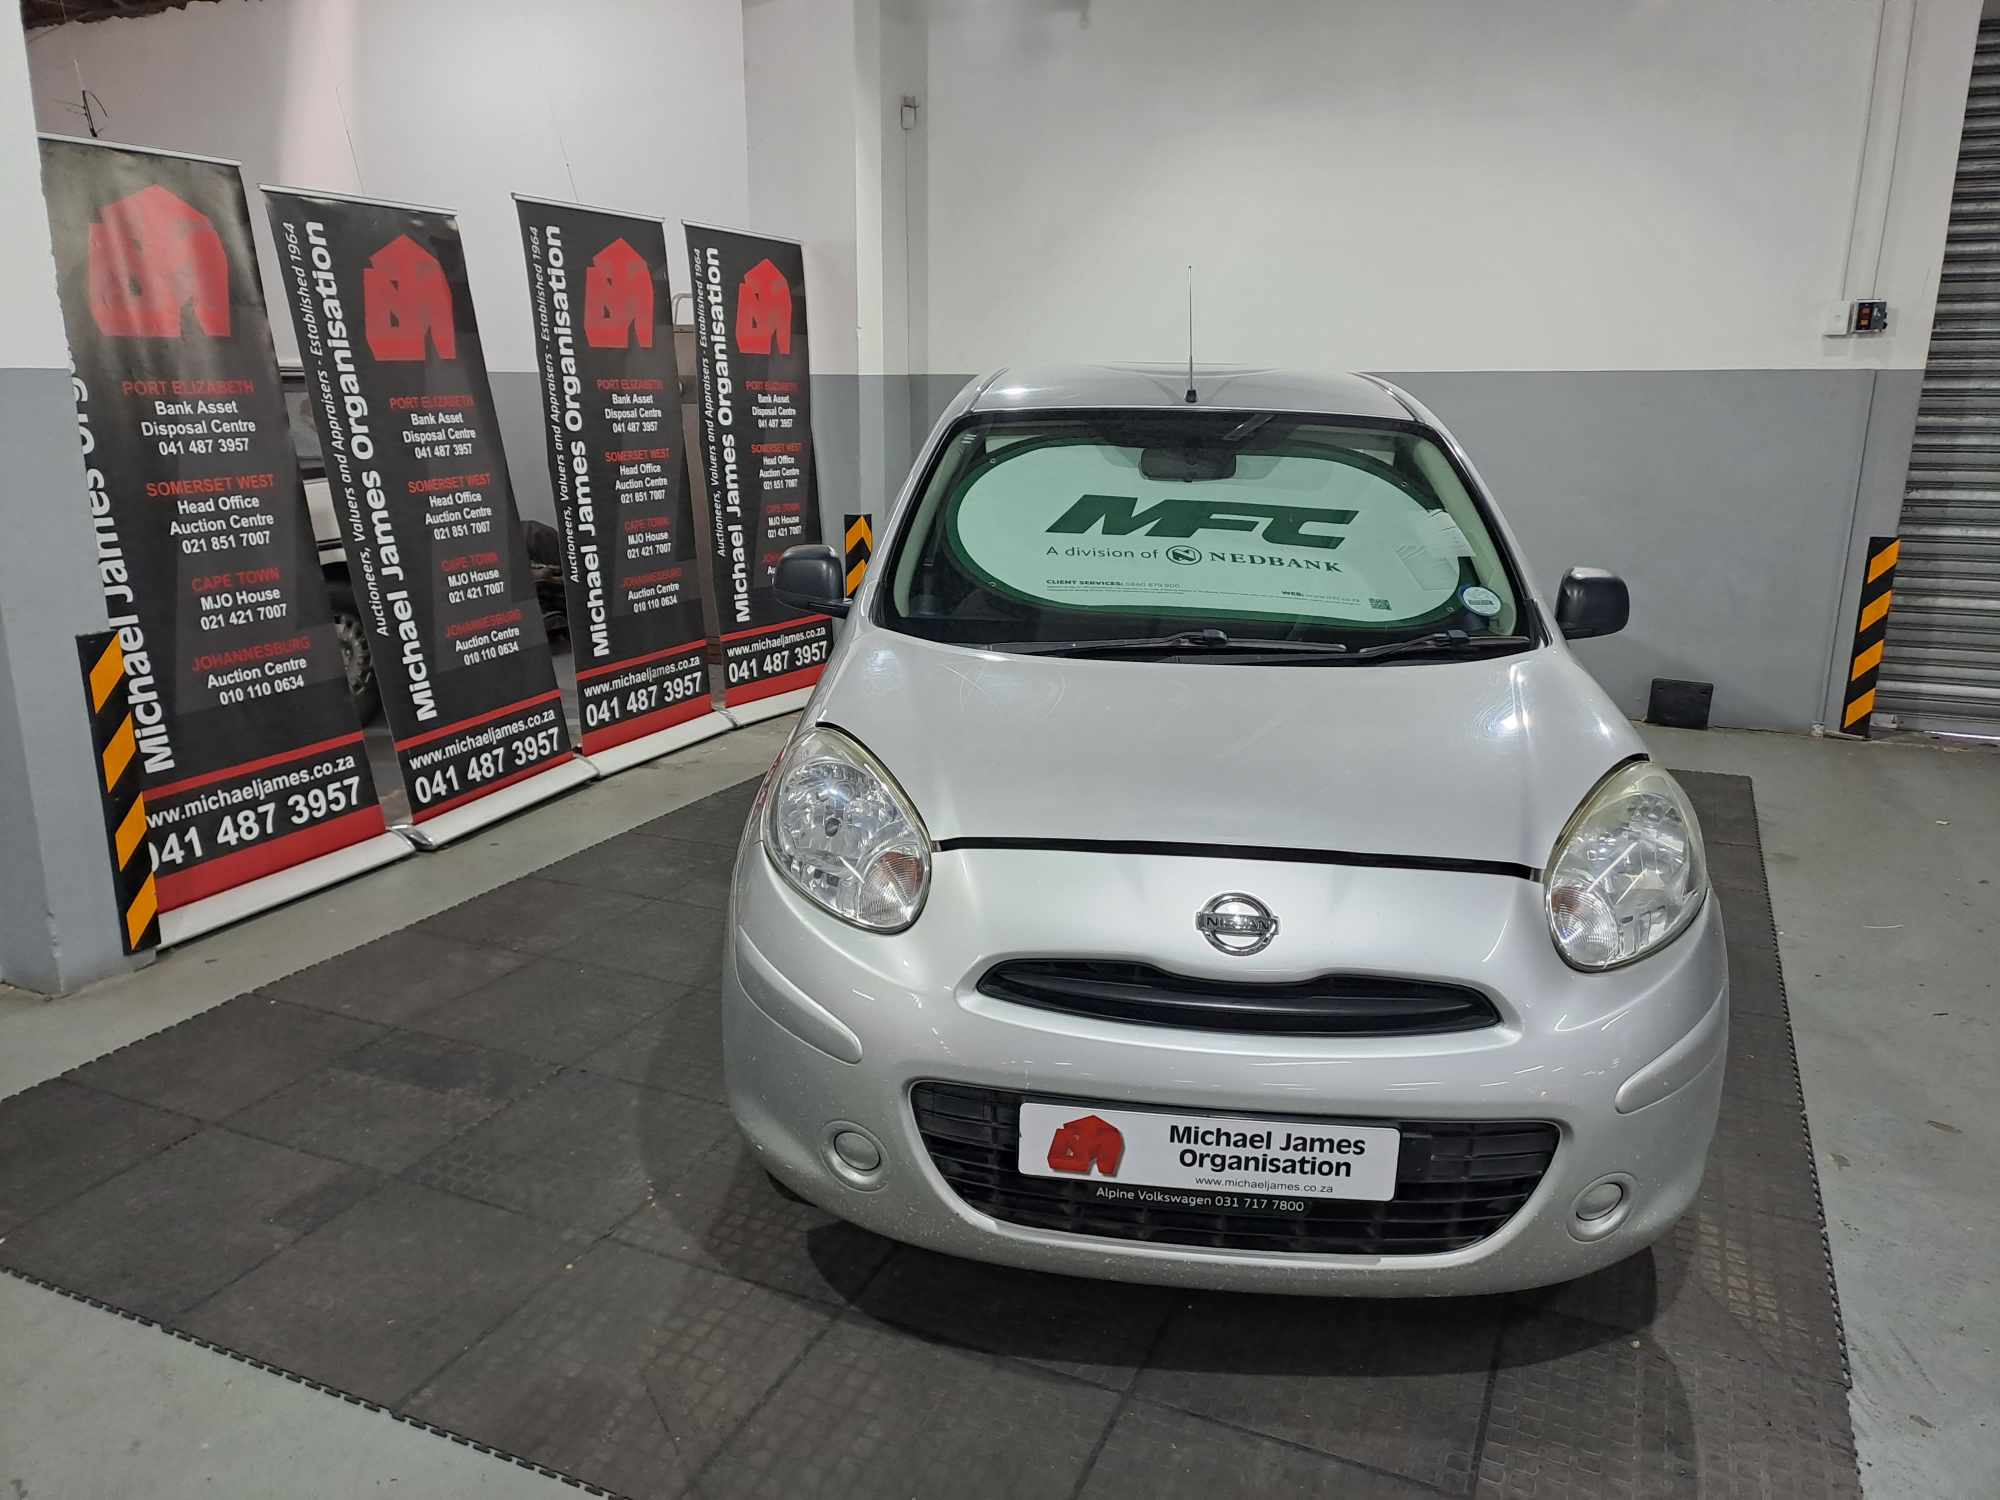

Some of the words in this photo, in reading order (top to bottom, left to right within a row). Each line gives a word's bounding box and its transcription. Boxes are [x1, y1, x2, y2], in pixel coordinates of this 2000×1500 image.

[283, 222, 302, 262] 1964
[529, 226, 543, 260] 1964
[292, 265, 324, 357] Established
[533, 263, 550, 341] Established
[306, 221, 374, 460] Organisation
[545, 225, 583, 432] Organisation
[706, 247, 733, 426] Organisation
[122, 380, 167, 396] PORT
[545, 352, 561, 423] Appraisers
[612, 393, 632, 405] Bank
[632, 393, 653, 404] Asset
[700, 357, 714, 418] Appraisers
[154, 401, 194, 416] Bank
[197, 400, 238, 415] Asset
[317, 370, 345, 450] Appraisers
[410, 413, 437, 425] Bank
[438, 412, 463, 424] Asset
[604, 408, 637, 420] Disposal
[639, 407, 662, 418] Centre
[141, 421, 207, 438] Disposal
[211, 419, 256, 433] Centre
[402, 429, 446, 444] Disposal
[448, 428, 476, 440] Centre
[551, 424, 563, 451] and
[612, 422, 626, 433] 041
[705, 420, 716, 443] and
[158, 441, 184, 456] 041
[189, 439, 213, 454] 487
[218, 437, 249, 452] 3957
[414, 447, 432, 459] 041
[434, 444, 450, 457] 487
[453, 443, 472, 456] 3957
[334, 454, 352, 483] and
[556, 454, 570, 501] Valuers
[620, 465, 638, 476] Head
[640, 463, 662, 474] Office
[709, 445, 719, 486] Valuers
[722, 434, 741, 518] James
[147, 477, 232, 497] SOMERSET
[237, 474, 274, 489] WEST
[570, 441, 597, 536] James
[615, 480, 643, 490] Auction
[645, 477, 668, 487] Centre
[177, 498, 214, 515] Head
[218, 495, 260, 510] Office
[429, 494, 453, 508] Head
[455, 491, 482, 504] Office
[620, 493, 633, 504] 021
[170, 518, 226, 535] Auction
[230, 513, 274, 529] Centre
[345, 487, 366, 542] Valuers
[362, 471, 404, 581] James
[425, 510, 461, 525] Auction
[463, 506, 492, 519] Centre
[1045, 494, 1360, 550] MFC
[86, 468, 133, 602] James
[182, 538, 207, 554] 021
[211, 534, 236, 550] 851
[240, 530, 271, 546] 7007
[433, 527, 450, 540] 021
[452, 524, 468, 538] 851
[470, 521, 491, 535] 7007
[563, 505, 580, 583] Auctioneers,
[628, 533, 644, 545] MJO
[645, 531, 669, 543] House
[627, 548, 639, 559] 021
[641, 546, 653, 557] 421
[655, 543, 671, 555] 7007
[1046, 546, 1058, 557] A
[1065, 546, 1134, 559] division
[1140, 548, 1159, 560] of
[1210, 551, 1342, 573] NEDBANK
[191, 574, 232, 592] CAPE
[237, 567, 281, 584] TOWN
[448, 573, 468, 588] MJO
[470, 569, 499, 583] House
[728, 524, 751, 622] Michael
[200, 593, 232, 611] MJO
[235, 588, 280, 604] House
[360, 547, 390, 637] Auctioneers,
[448, 590, 465, 604] 021
[466, 586, 482, 599] 421
[484, 581, 504, 595] 7007
[580, 545, 610, 657] Michael
[628, 587, 655, 601] Auction
[656, 582, 680, 594] Centre
[200, 614, 225, 631] 021
[229, 609, 253, 625] 421
[257, 603, 287, 620] 7007
[455, 635, 490, 653] Auction
[491, 627, 520, 642] Centre
[727, 627, 826, 658] www.michaeljames.co.za
[387, 590, 438, 722] Michael
[463, 651, 480, 666] 010
[481, 646, 497, 661] 110
[728, 658, 758, 683] 041
[763, 650, 789, 674] 487
[794, 640, 827, 666] 3957
[207, 666, 261, 689] Auction
[264, 657, 307, 676] Centre
[584, 656, 700, 698] www.michaeljames.co.za
[107, 614, 175, 774] Michael
[219, 687, 244, 705] 010
[247, 682, 271, 699] 110
[274, 674, 304, 692] 0634
[586, 696, 620, 727] 041
[626, 685, 658, 713] 487
[664, 671, 702, 702] 3957
[409, 709, 556, 770] www.michaeljames.co.za
[415, 764, 459, 804] 041
[467, 747, 504, 782] 487
[512, 727, 559, 765] 3957
[146, 755, 356, 829] ww.michaeljames.co.za
[217, 802, 276, 846] 487
[287, 776, 360, 824] 3957
[1169, 1125, 1272, 1151] Michael
[1279, 1131, 1367, 1157] James
[1178, 1150, 1352, 1178] Organisation
[1096, 1186, 1135, 1202] Alpine
[1138, 1190, 1212, 1207] Volkswagen
[1214, 1196, 1239, 1208] 031
[1244, 1198, 1268, 1210] 717
[1272, 1200, 1305, 1212] 7800
[1195, 1176, 1334, 1194] www.michaeljames.co.za
